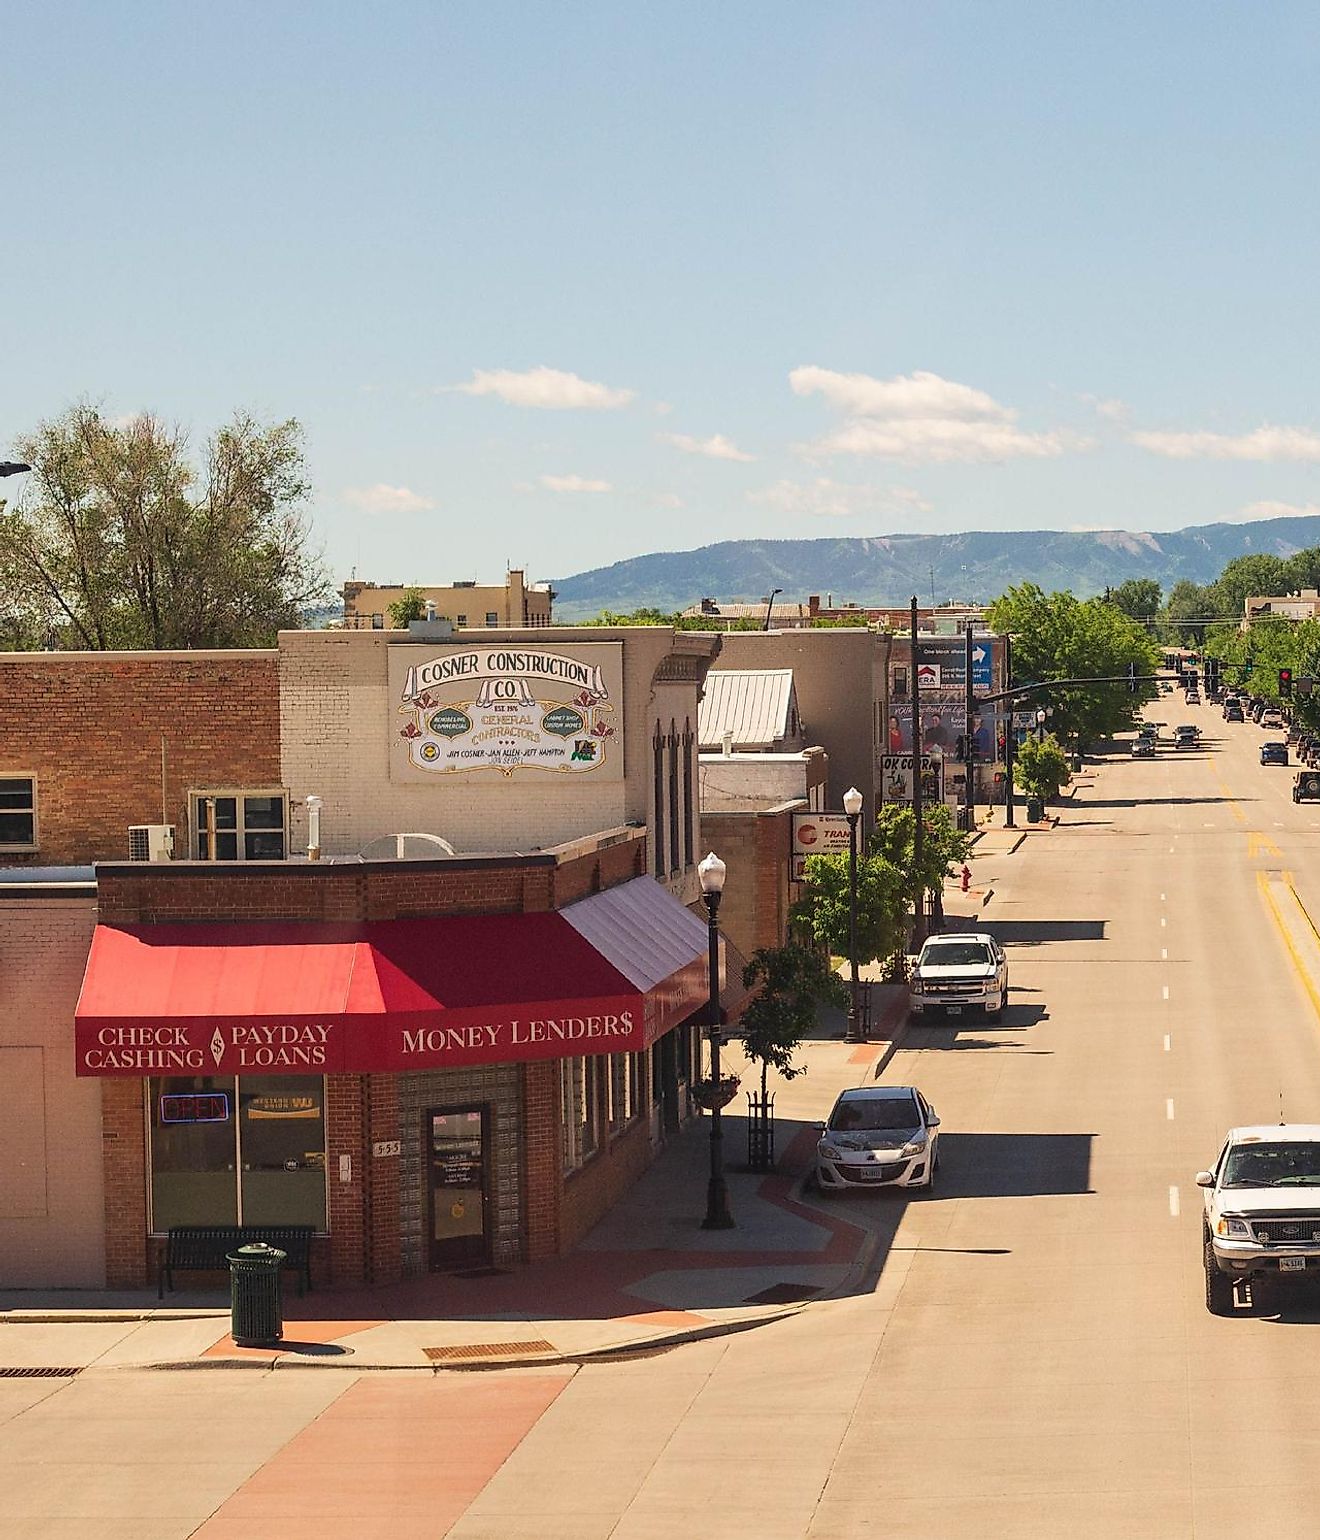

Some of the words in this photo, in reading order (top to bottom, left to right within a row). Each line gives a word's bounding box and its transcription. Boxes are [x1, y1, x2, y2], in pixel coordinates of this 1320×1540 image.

[422, 654, 479, 683] COSNER
[487, 653, 588, 684] CONSTRUCTION
[494, 681, 518, 698] CO.
[885, 758, 899, 769] OK
[824, 830, 851, 838] TRAN
[99, 1027, 190, 1046] CHECK
[231, 1024, 333, 1045] PAYDAY
[401, 1024, 503, 1054] MONEY
[511, 1010, 633, 1044] LENDER$
[84, 1049, 205, 1068] CASHING
[240, 1046, 326, 1067] LOANS
[165, 1098, 225, 1119] OPEN
